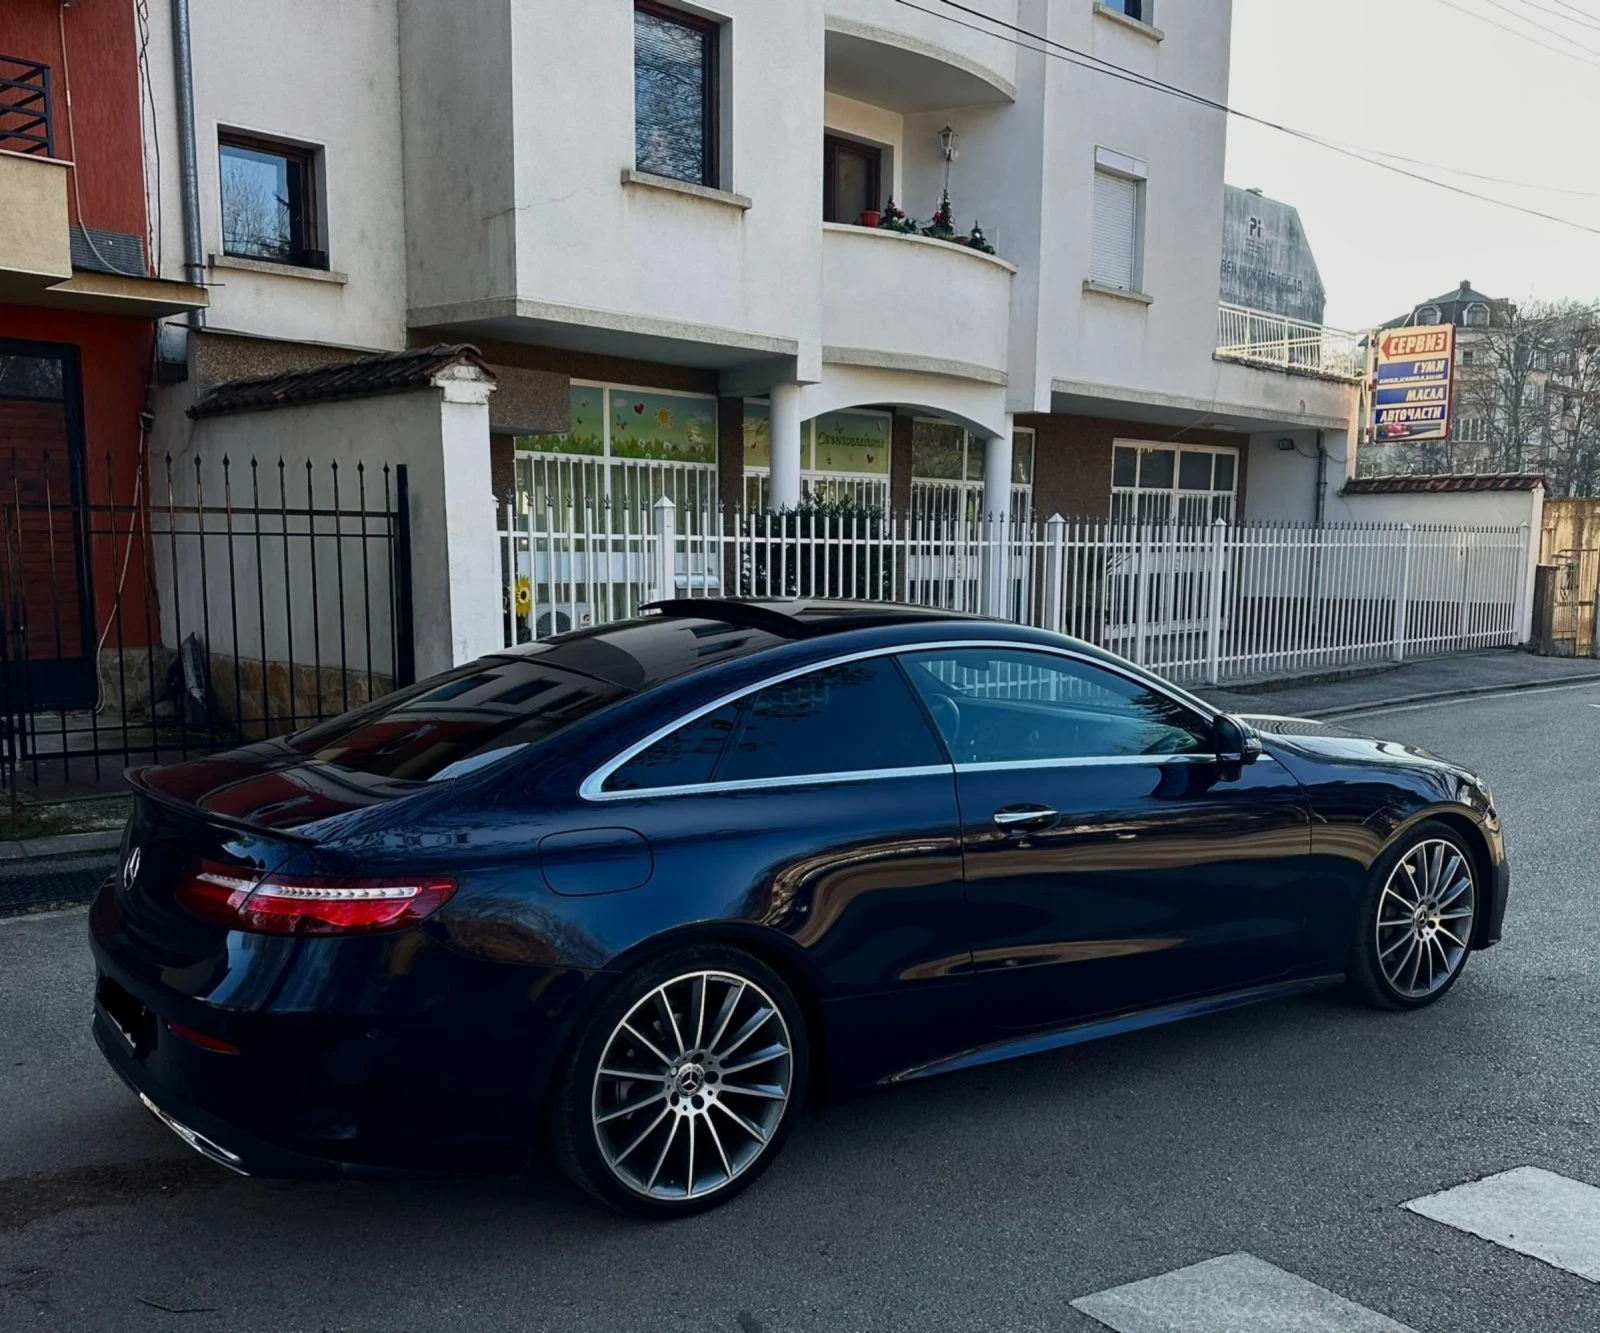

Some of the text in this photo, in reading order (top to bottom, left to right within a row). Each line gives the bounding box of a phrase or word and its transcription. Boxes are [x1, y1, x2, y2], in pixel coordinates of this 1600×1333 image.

[1389, 333, 1444, 354] СЕРВИЗ
[1413, 360, 1444, 373] ГУМИ
[1406, 387, 1444, 402] МАСЛА
[1380, 407, 1442, 422] АВТОЧАСТИ
